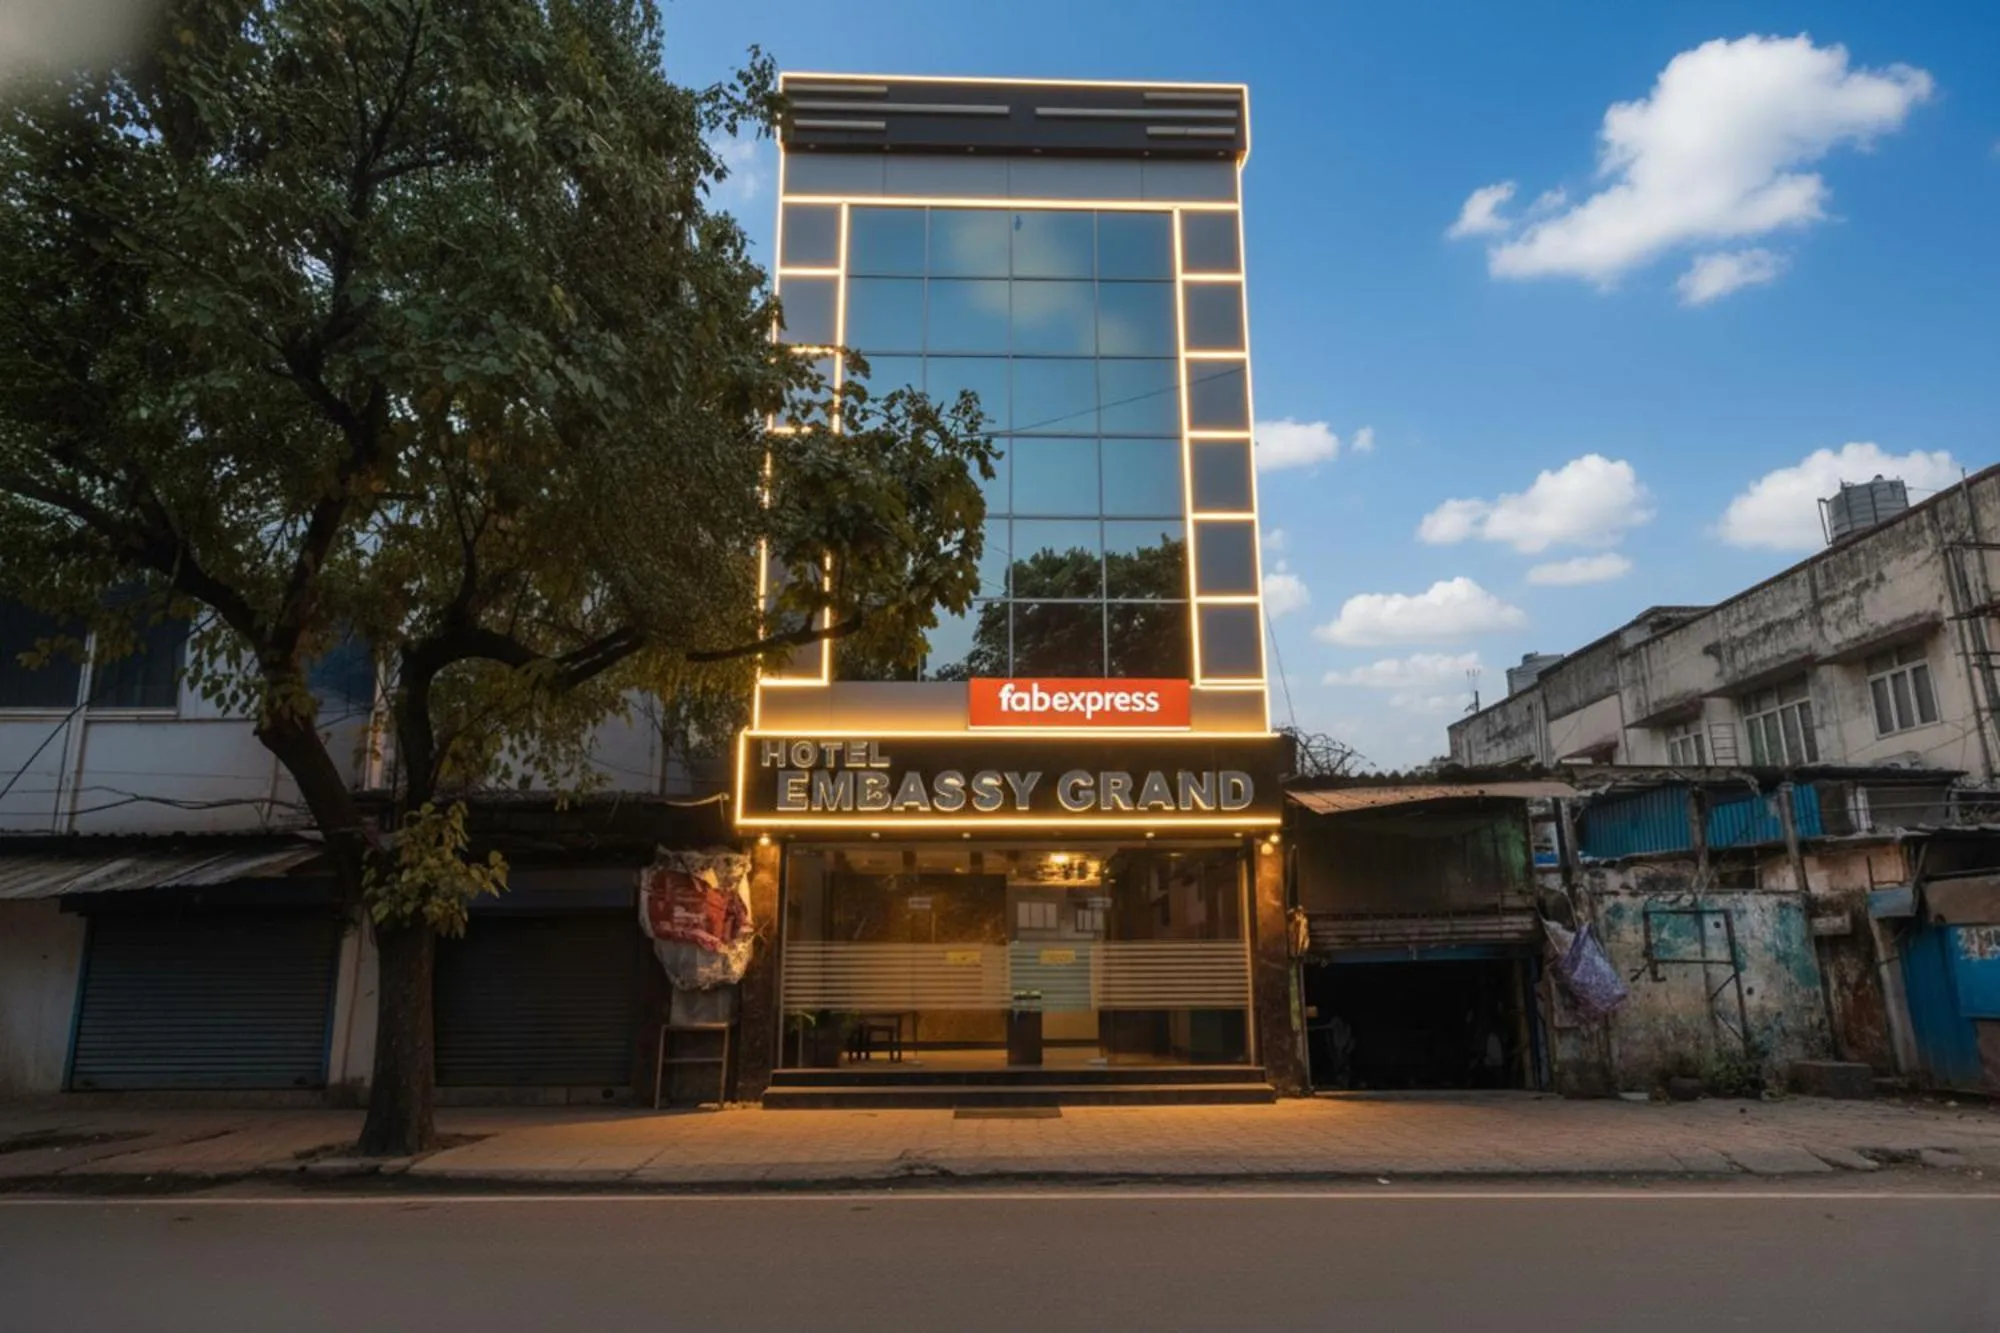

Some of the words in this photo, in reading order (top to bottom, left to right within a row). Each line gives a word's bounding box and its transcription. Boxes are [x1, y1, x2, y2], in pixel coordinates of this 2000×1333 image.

[999, 682, 1160, 719] fabexpress
[761, 741, 891, 769] HOTEL
[776, 770, 1043, 812] EMBASSY
[1057, 769, 1255, 812] GRAND
